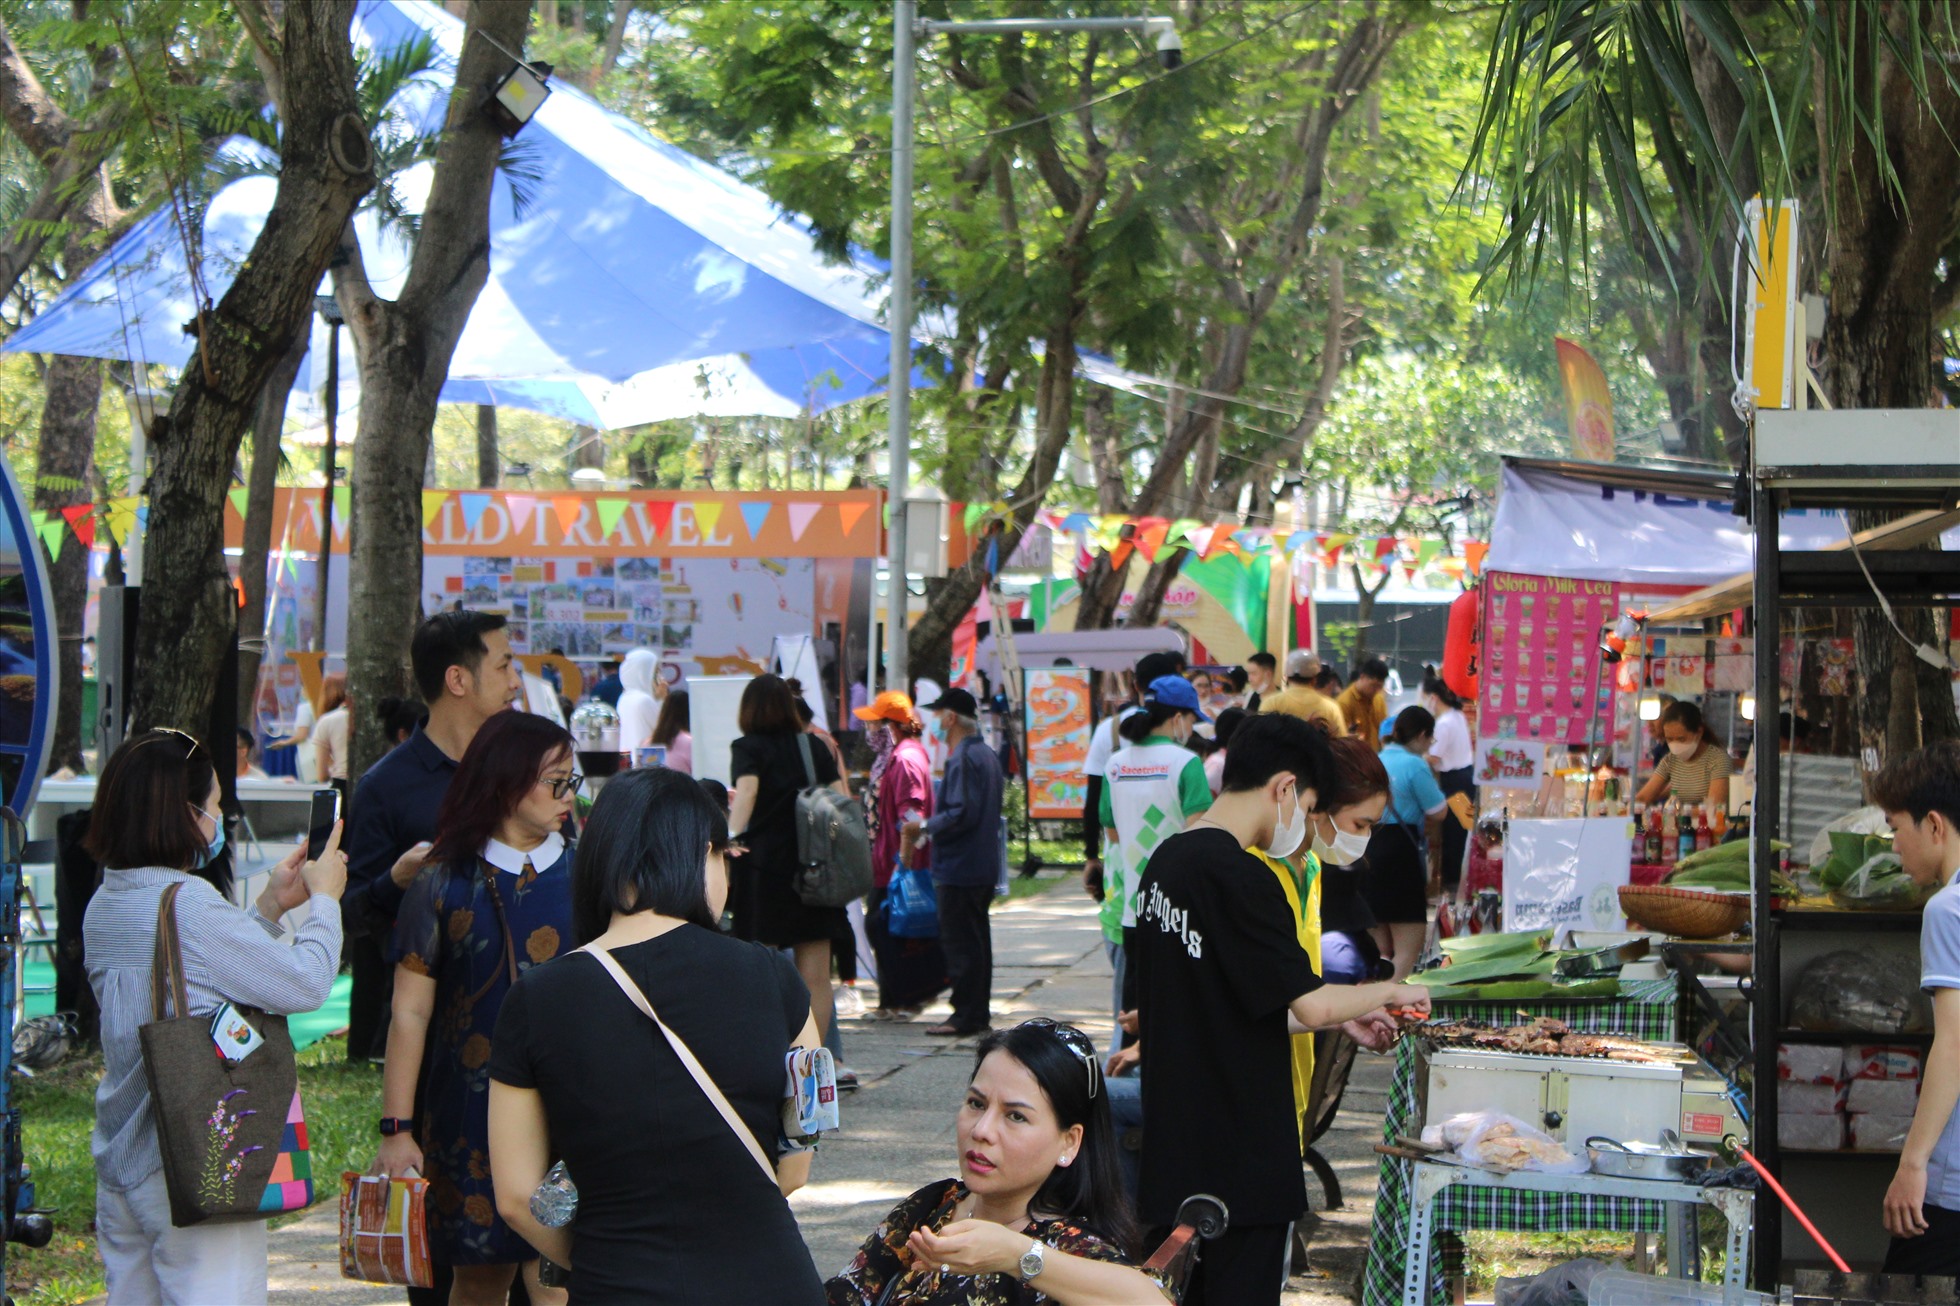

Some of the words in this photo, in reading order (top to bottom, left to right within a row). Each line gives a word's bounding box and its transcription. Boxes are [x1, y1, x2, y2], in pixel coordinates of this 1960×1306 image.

[303, 497, 510, 547] WLD
[1493, 573, 1539, 593] Gloria
[1543, 576, 1578, 595] Milk
[1145, 881, 1203, 960] Angels
